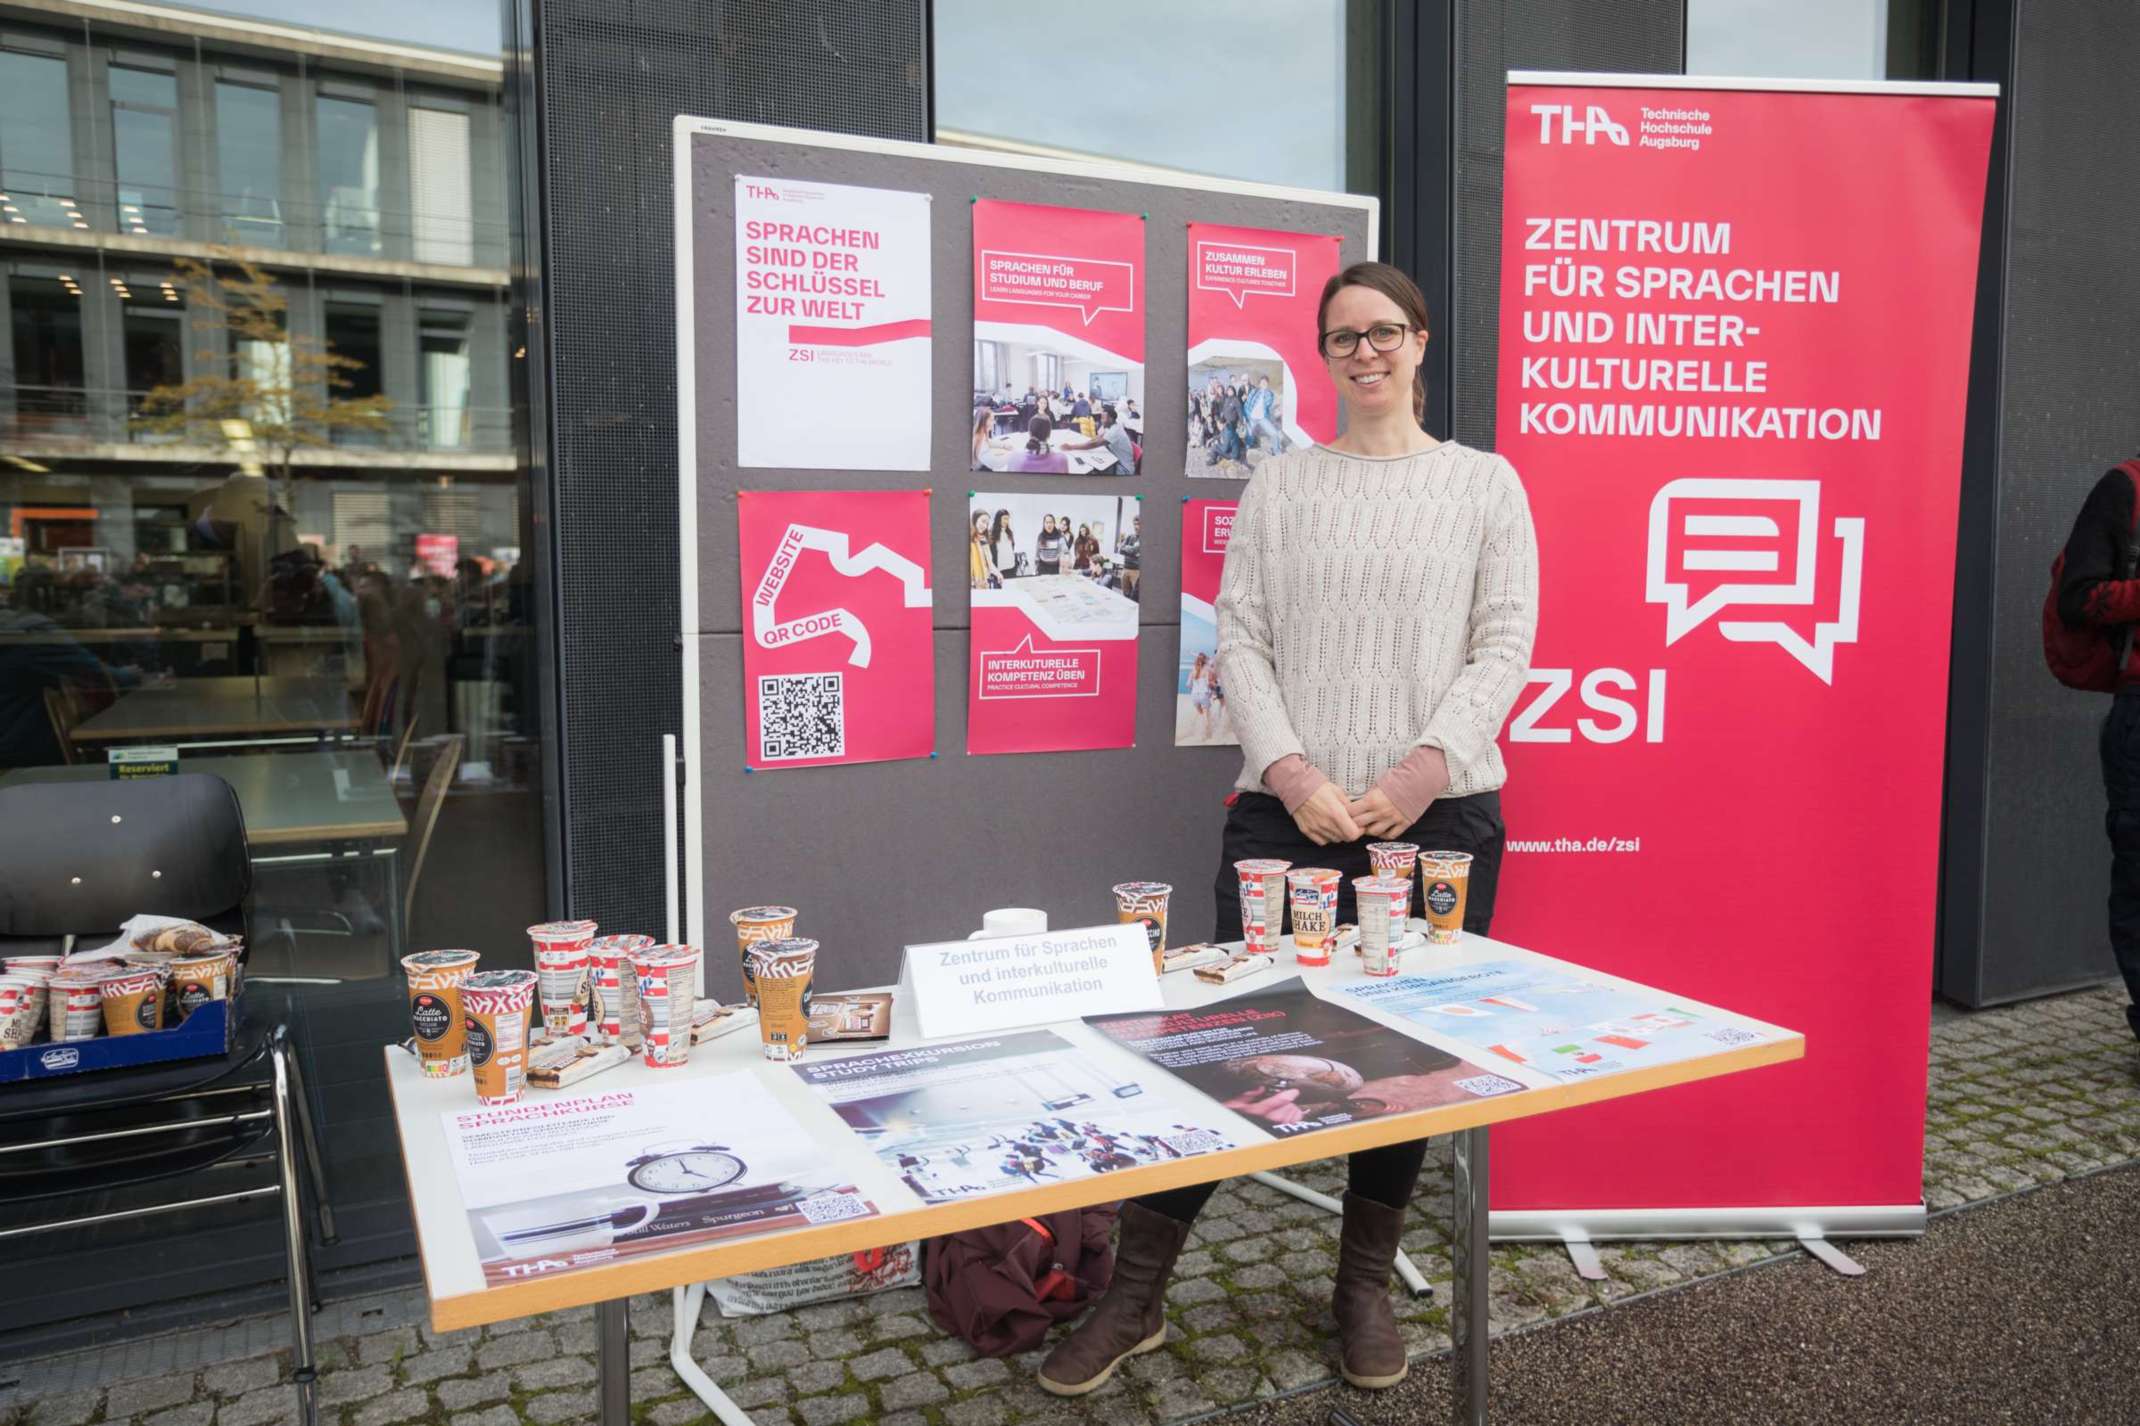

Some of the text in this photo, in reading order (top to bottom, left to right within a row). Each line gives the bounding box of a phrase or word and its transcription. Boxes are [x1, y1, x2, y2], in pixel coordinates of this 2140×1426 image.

[1640, 107, 1710, 121] Technische
[1640, 122, 1712, 135] Hochschule
[1639, 136, 1700, 150] Augsburg
[746, 221, 880, 250] SPRACHEN
[1524, 218, 1731, 254] ZENTRUM
[746, 245, 859, 272] SIND DER
[990, 260, 1075, 277] SPRACHEN FÜR
[1205, 251, 1265, 266] ZUSAMMEN
[1205, 263, 1287, 280] KULTUR ERLEBEN
[746, 270, 886, 299] SCHLÜSSEL
[990, 272, 1104, 292] STUDIUM UND BERUF
[1524, 257, 1840, 303] FÜR SPRACHEN
[746, 295, 865, 321] ZUR WELT
[1523, 311, 1760, 347] UND INTER-
[788, 348, 815, 362] ZSI
[1521, 357, 1767, 393] KULTURELLE
[1519, 402, 1882, 441] KOMMUNIKATION
[755, 529, 804, 607] WEBSITE
[764, 613, 843, 644] QR CODE
[987, 668, 1085, 682] KOMPETENZ ÜBEN
[1508, 667, 1667, 744] ZSI
[1506, 837, 1641, 853] www.tha.de/zsi
[1293, 910, 1323, 921] MILCH
[939, 934, 1117, 967] Zentrum für Sprachen
[959, 956, 1108, 986] und interkulturelle
[973, 977, 1103, 1005] Kommunikation
[811, 1055, 940, 1080] STUDY TRIPS
[456, 1091, 634, 1123] STUNDENPLAN
[458, 1100, 636, 1130] SPRACHKURSE
